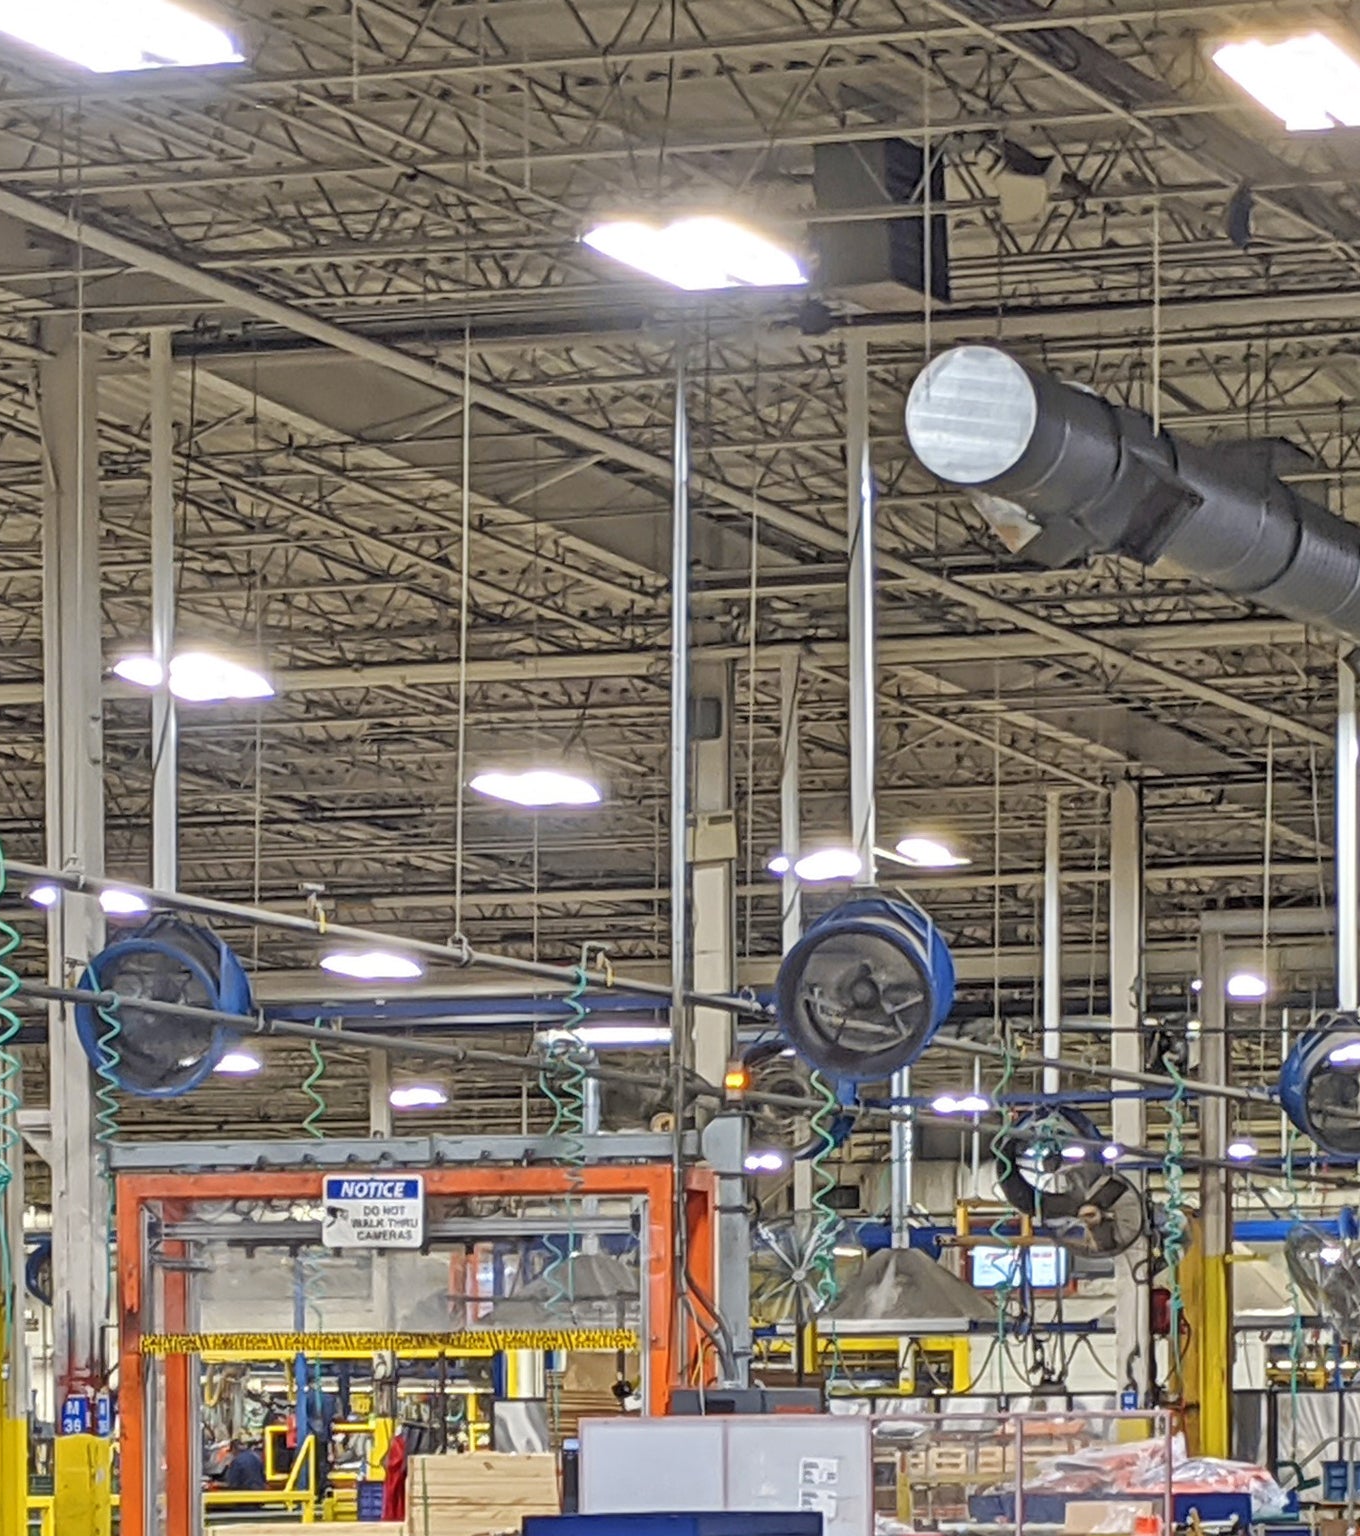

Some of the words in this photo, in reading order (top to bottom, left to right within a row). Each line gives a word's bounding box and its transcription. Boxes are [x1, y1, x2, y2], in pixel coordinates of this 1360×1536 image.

[340, 1181, 406, 1198] NOTICE
[363, 1205, 380, 1216] DO
[383, 1205, 406, 1216] NOT
[351, 1218, 384, 1228] WALK
[387, 1218, 418, 1228] THRU
[357, 1230, 413, 1241] CAMERAS
[64, 1400, 80, 1415] M
